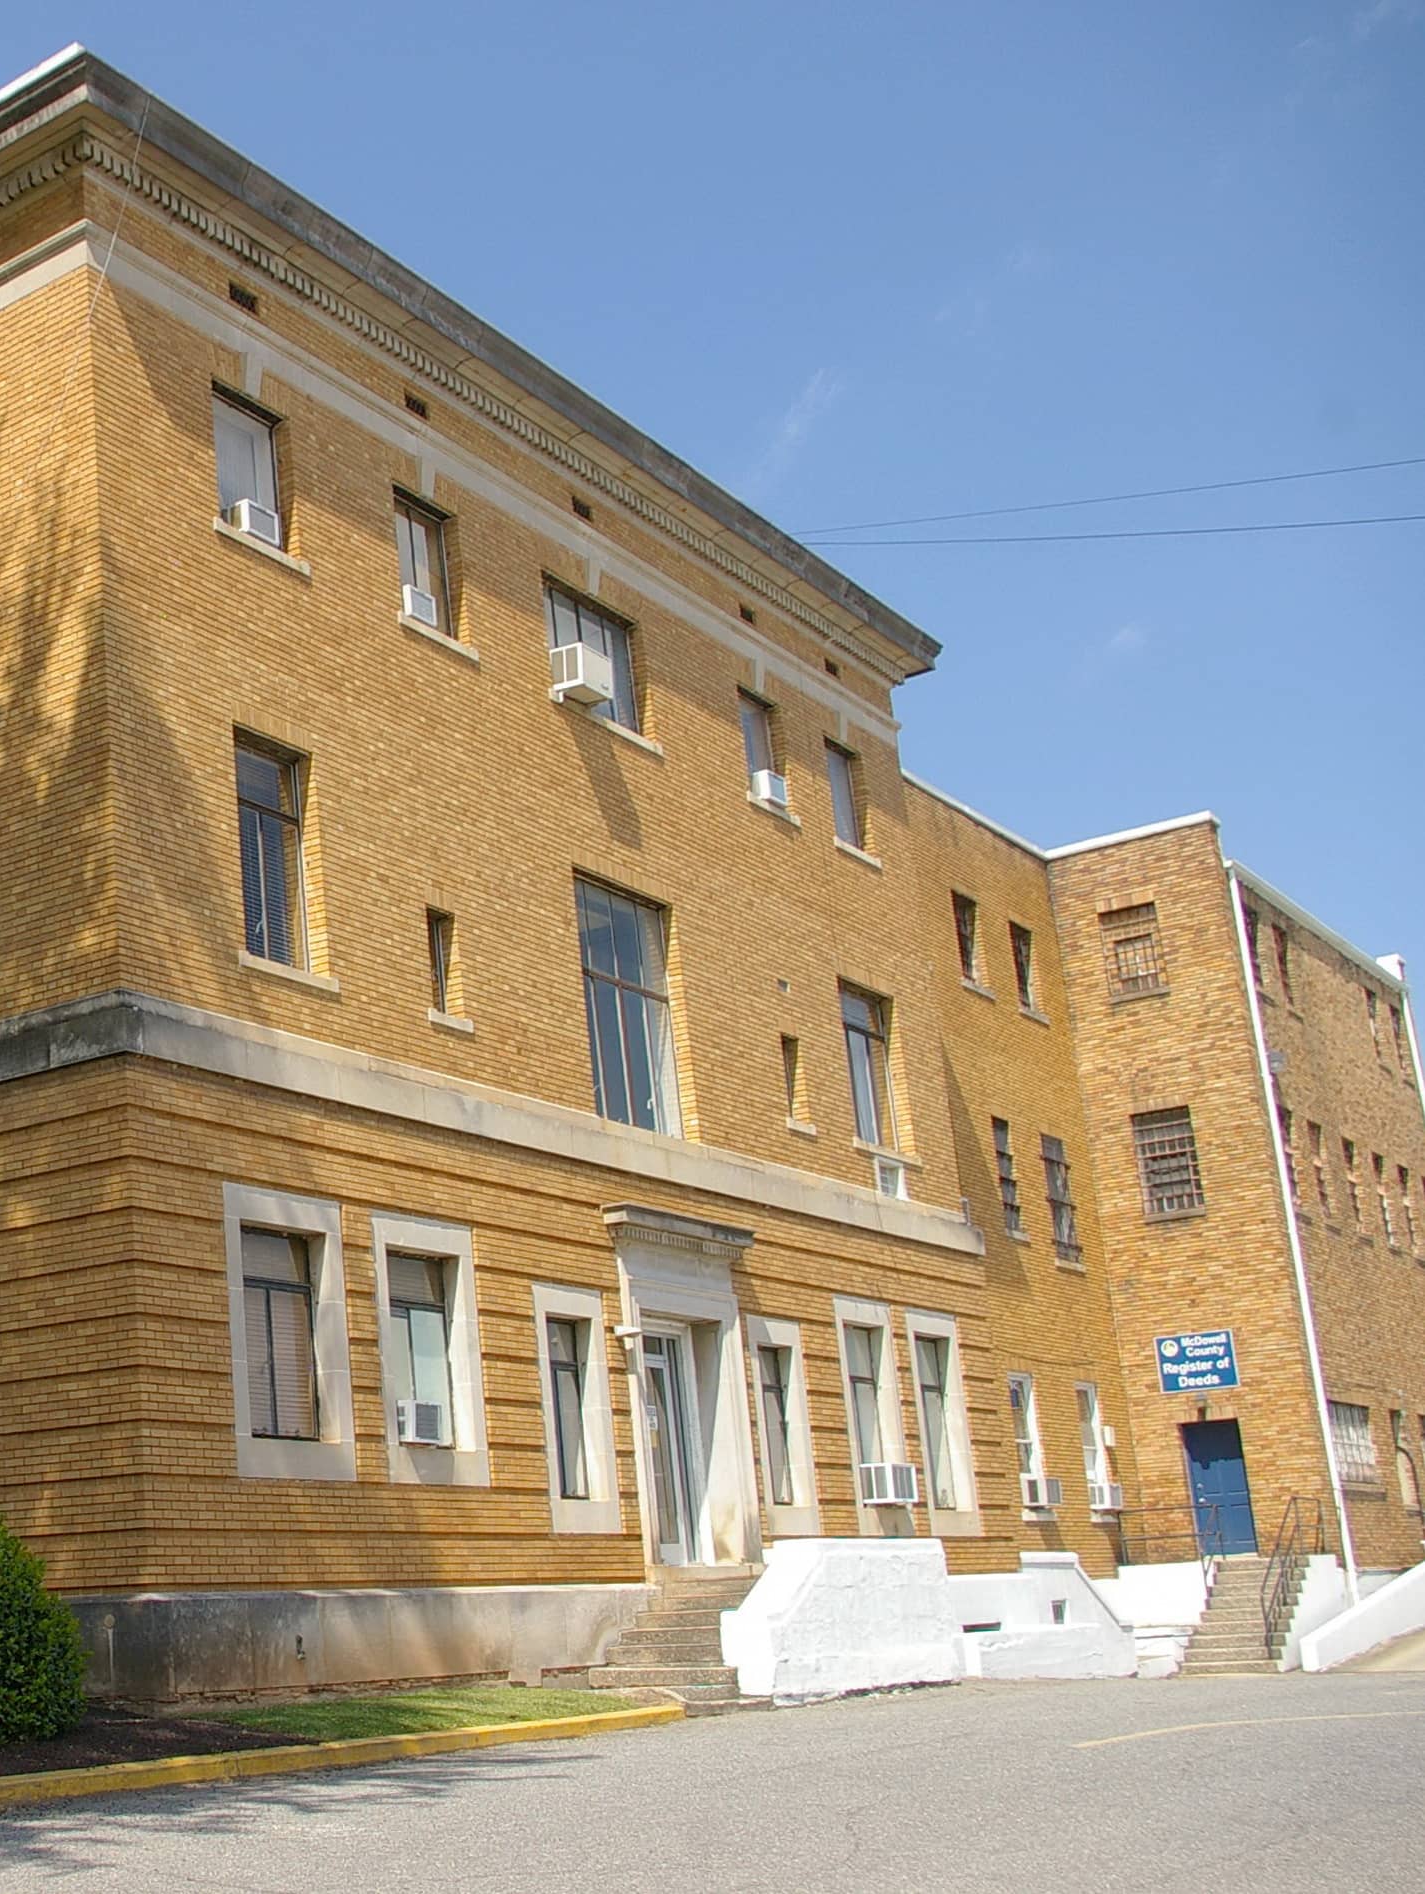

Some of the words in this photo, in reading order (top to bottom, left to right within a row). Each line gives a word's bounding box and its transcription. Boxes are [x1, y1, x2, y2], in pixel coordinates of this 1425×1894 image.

[1186, 1345, 1224, 1357] County
[1162, 1361, 1213, 1375] Register
[1216, 1356, 1230, 1369] of
[1178, 1374, 1220, 1387] Deeds
